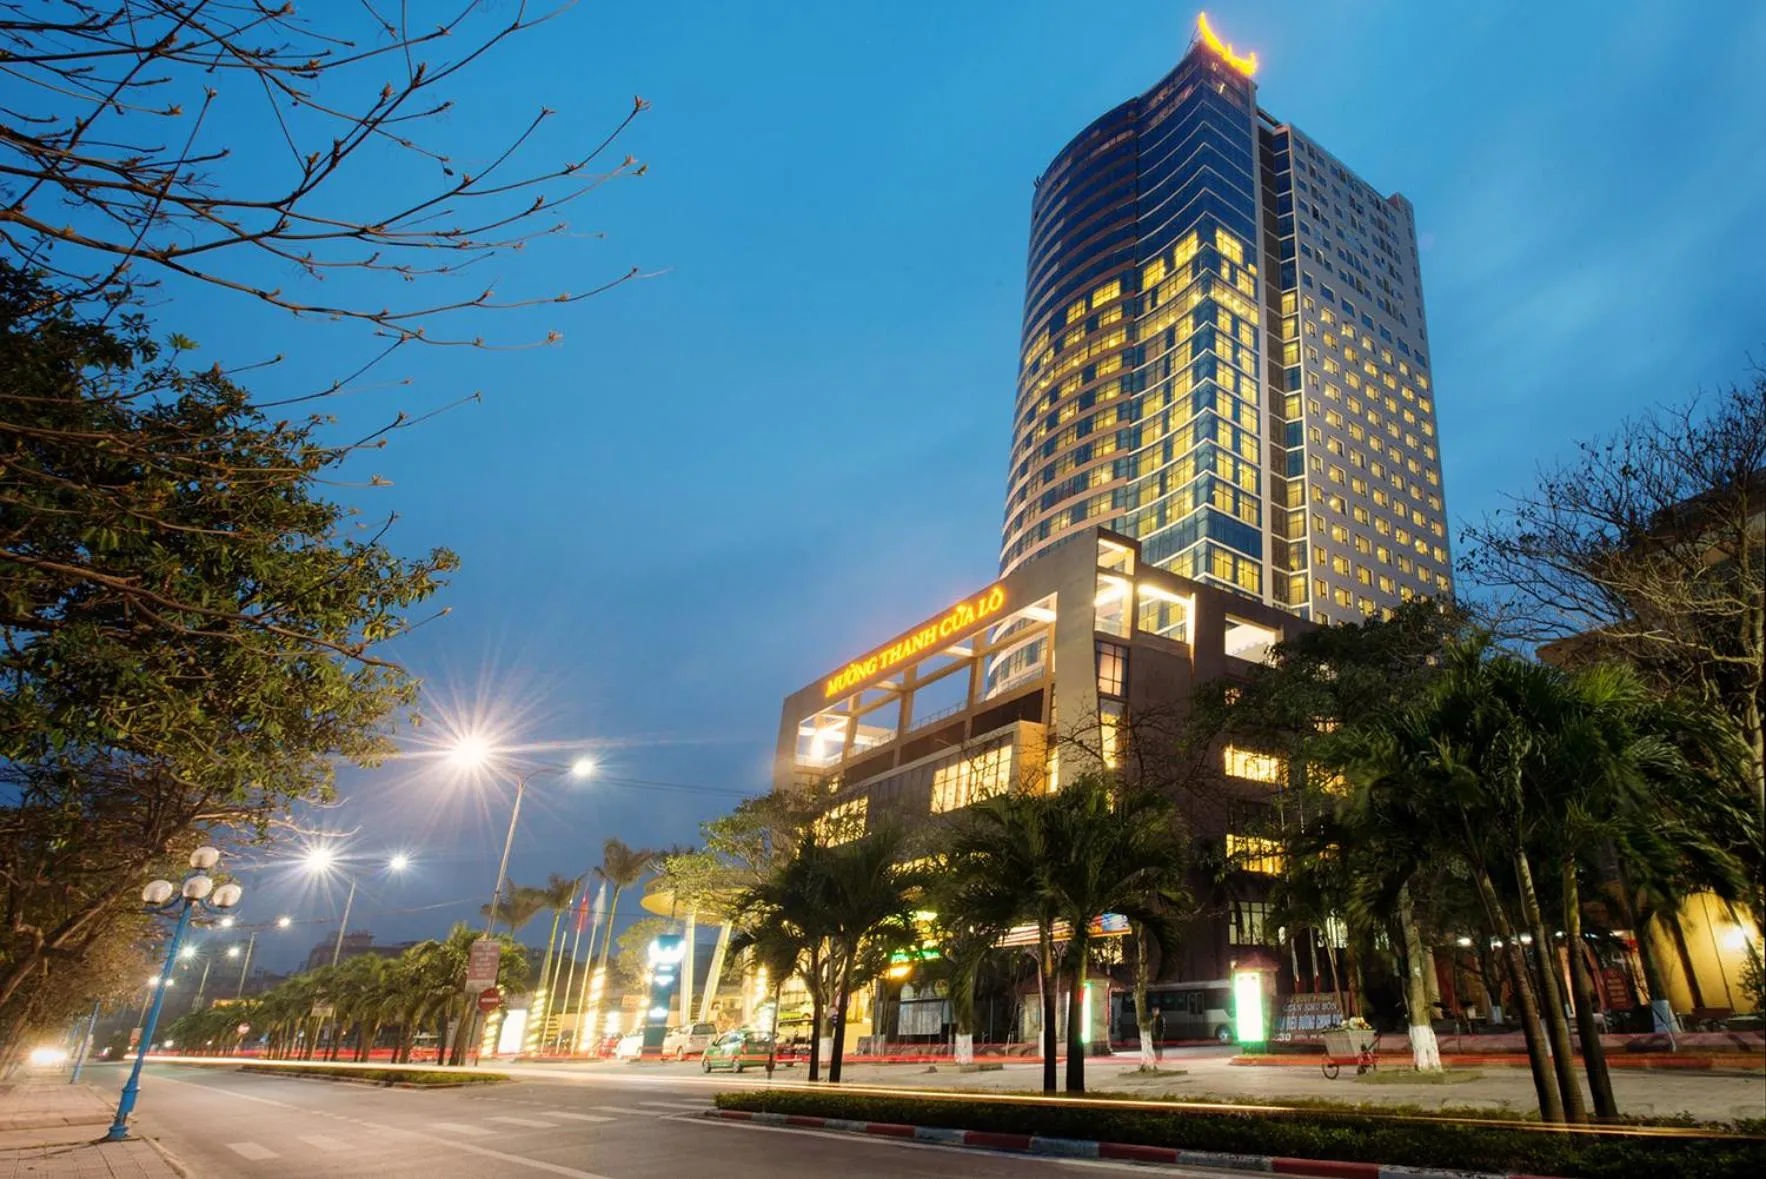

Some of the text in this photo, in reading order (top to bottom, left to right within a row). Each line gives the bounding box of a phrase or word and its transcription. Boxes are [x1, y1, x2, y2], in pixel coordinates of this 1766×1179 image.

[825, 587, 1005, 698] MƯỜNG THANH CỬA LÒ
